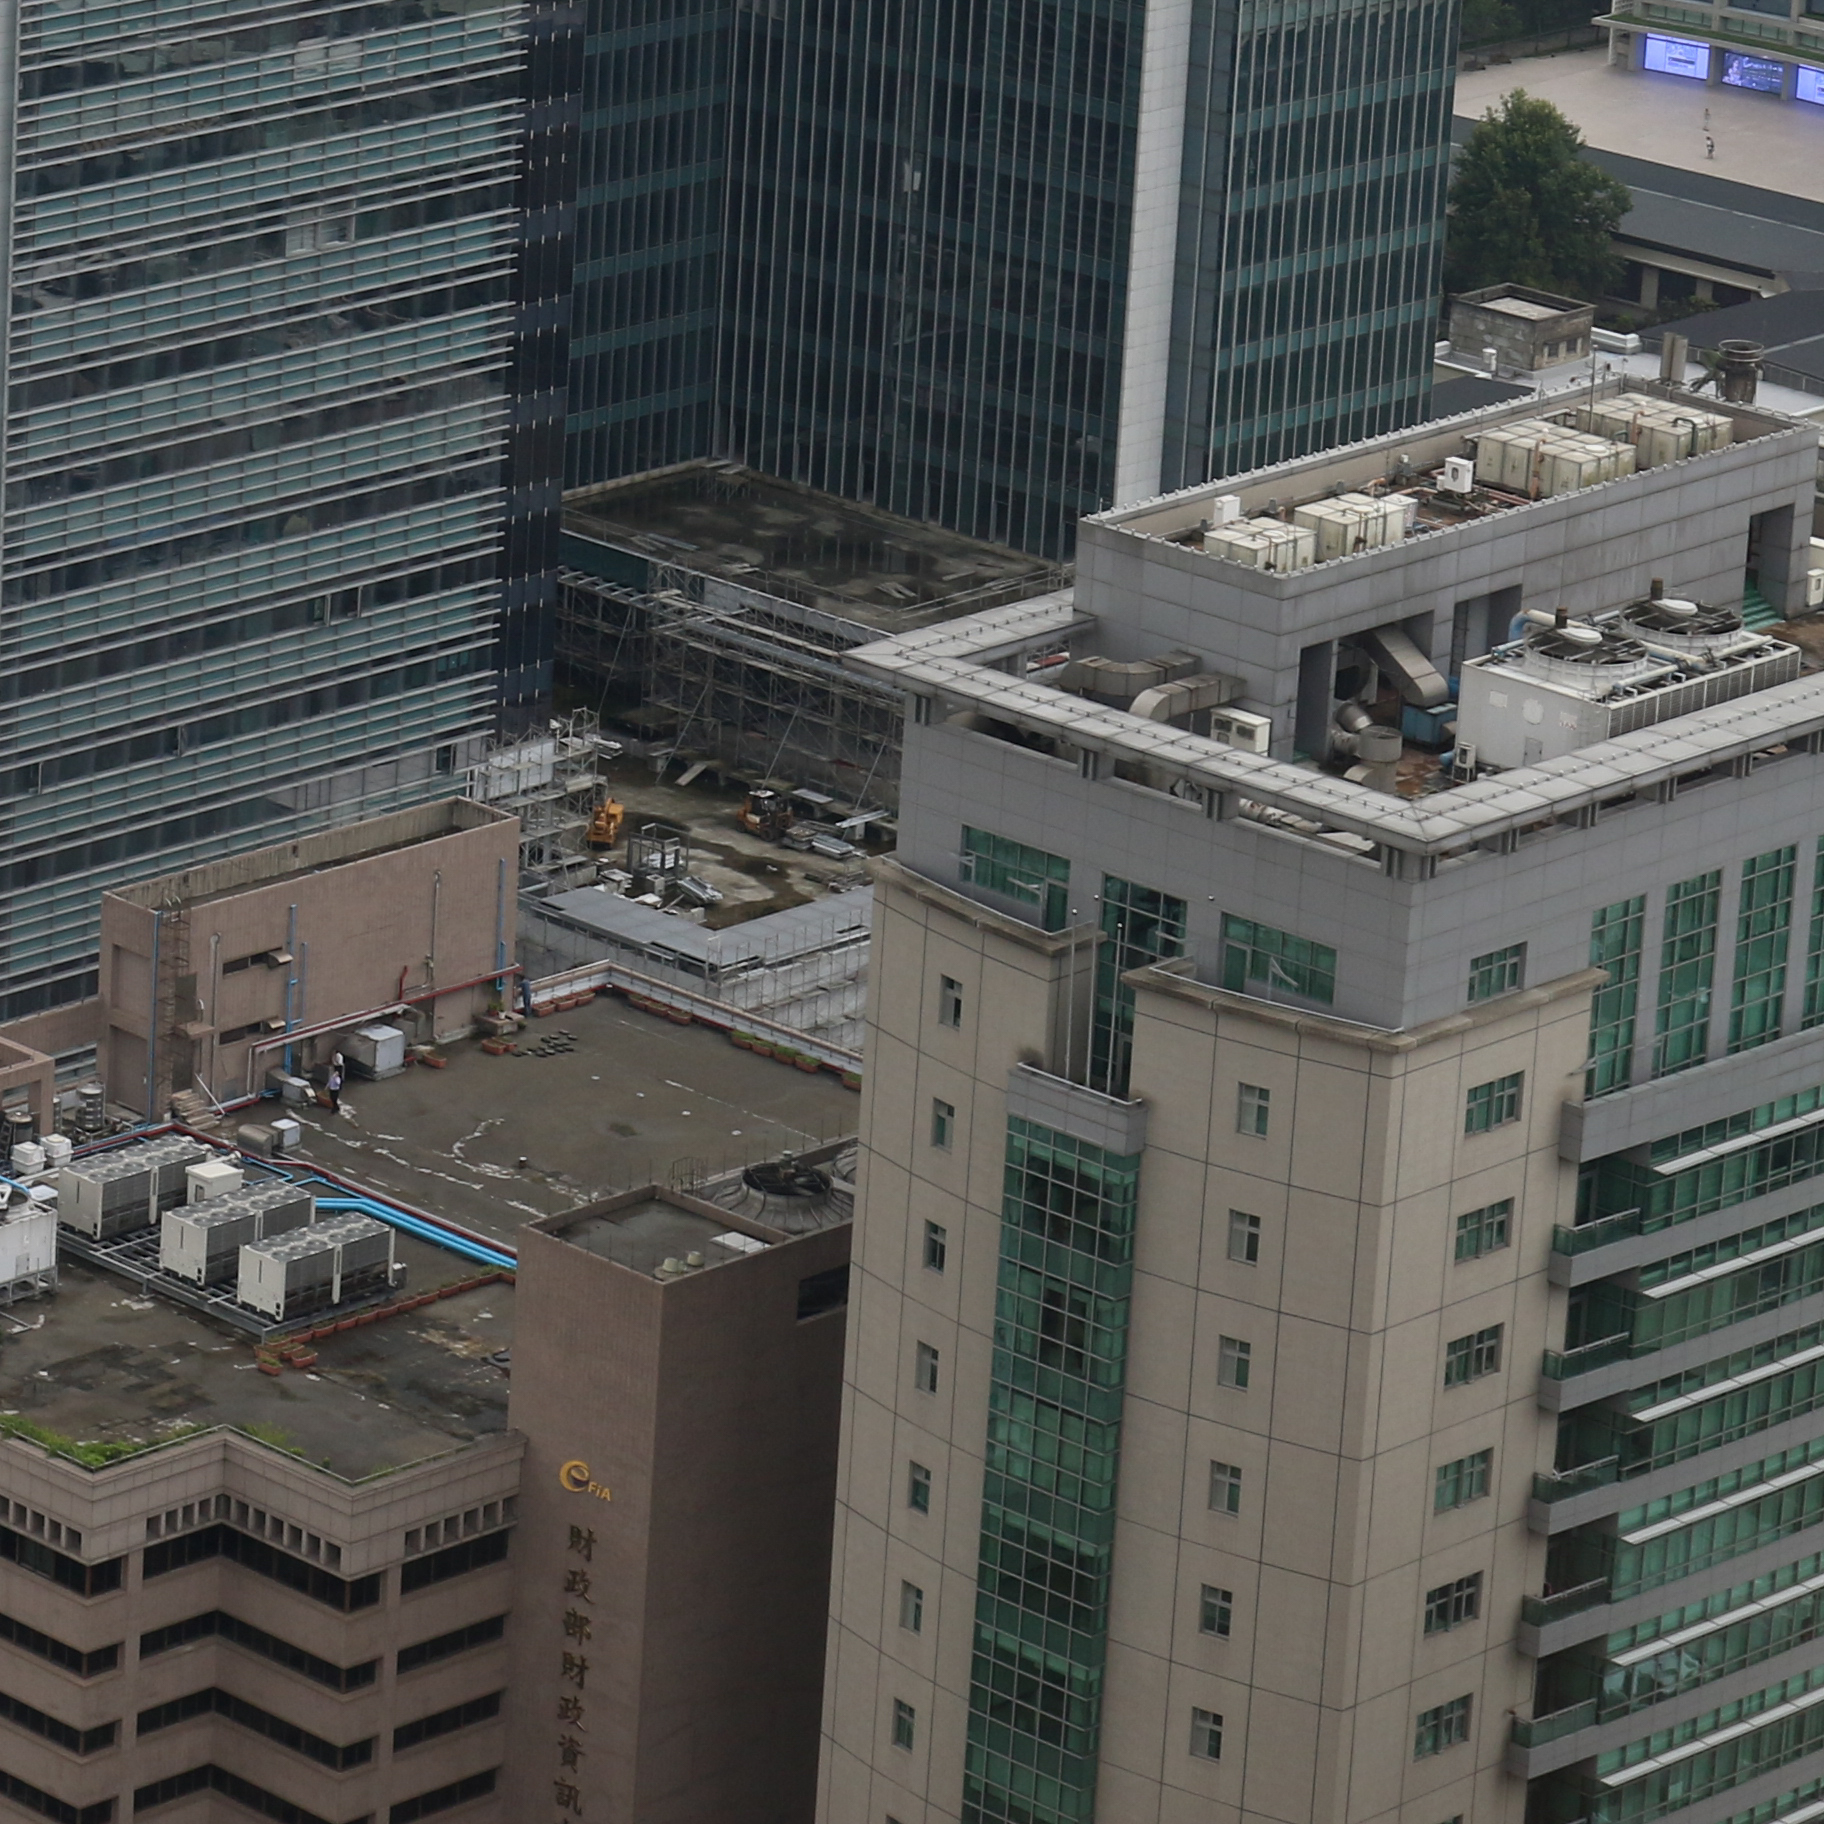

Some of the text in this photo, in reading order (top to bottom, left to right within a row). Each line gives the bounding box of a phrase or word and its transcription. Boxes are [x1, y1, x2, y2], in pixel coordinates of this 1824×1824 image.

[553, 1524, 598, 1824] 財政部財政資訊
